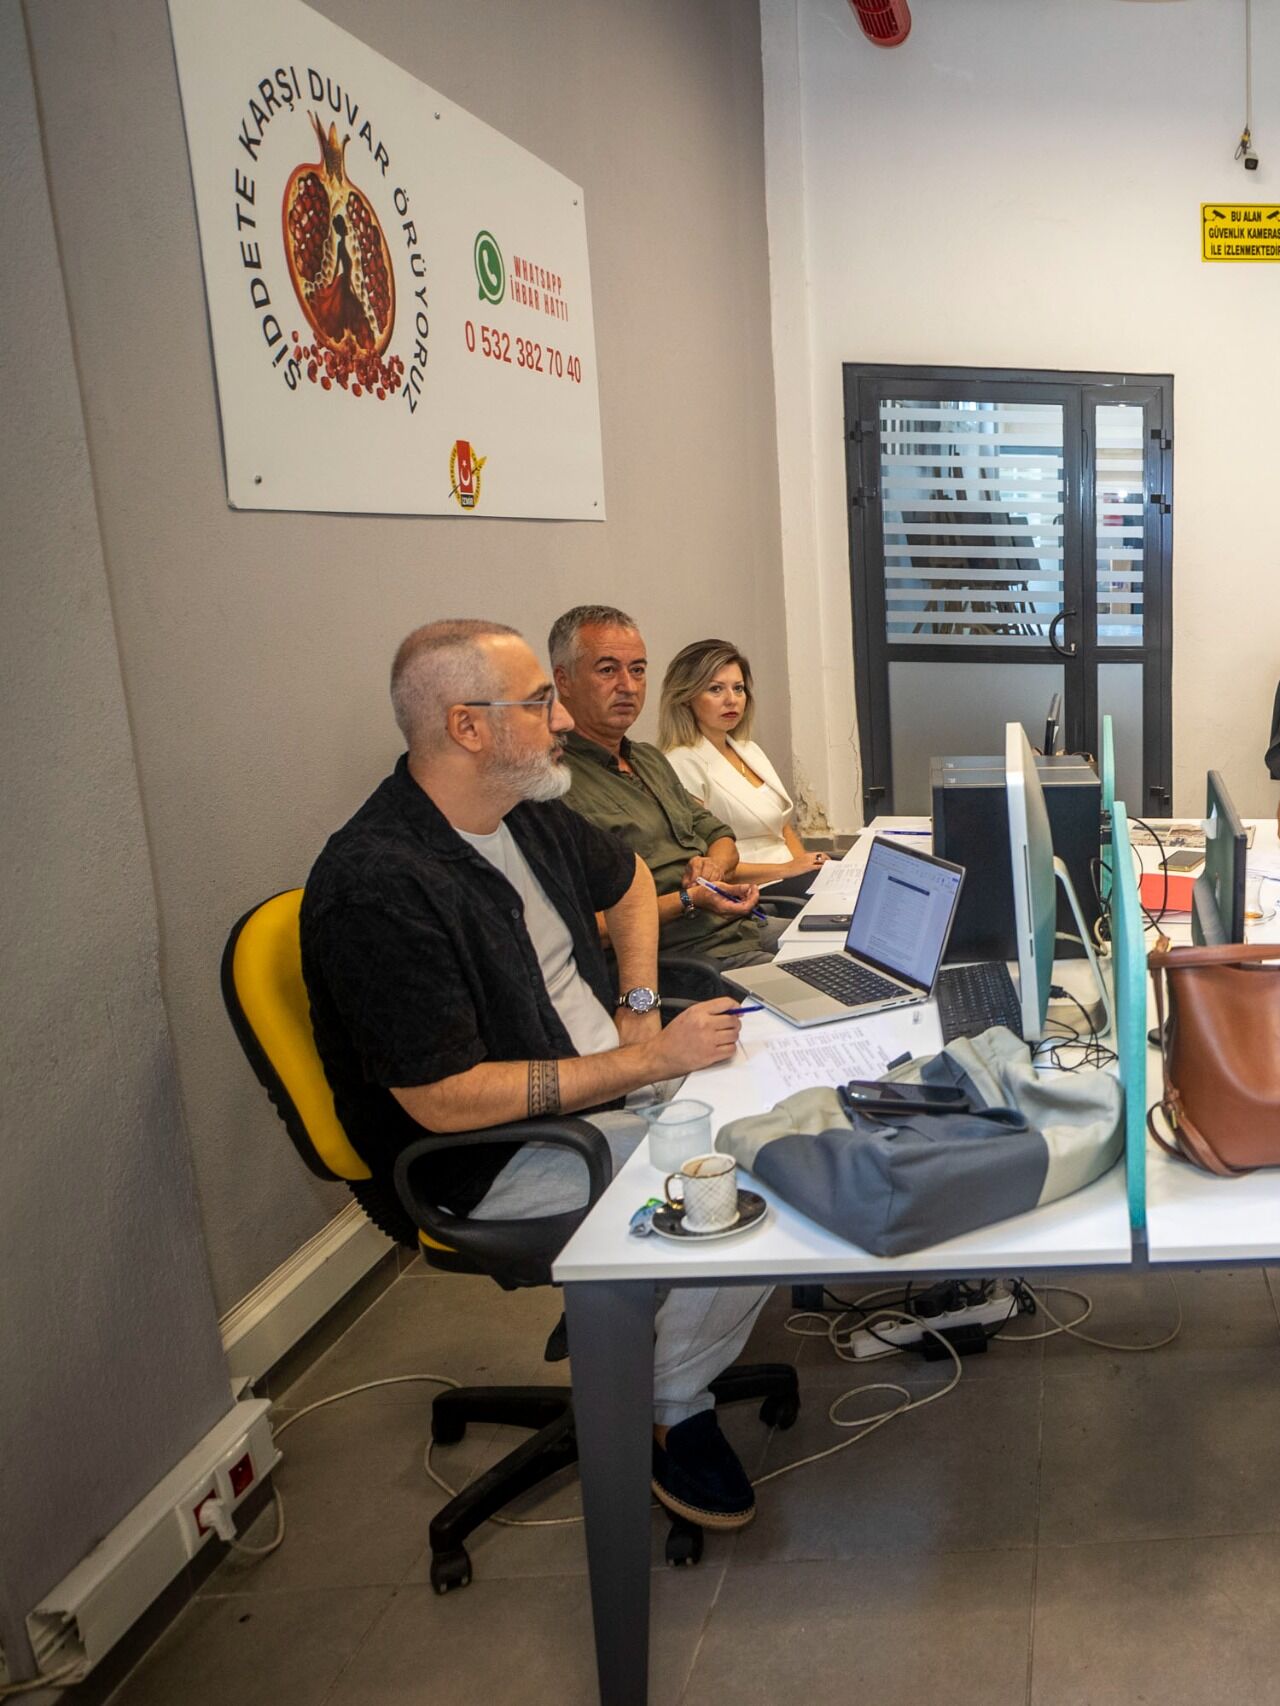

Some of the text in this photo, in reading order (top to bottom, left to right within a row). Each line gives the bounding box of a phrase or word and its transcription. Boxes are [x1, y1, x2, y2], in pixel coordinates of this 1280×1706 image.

[1208, 225, 1245, 239] GÜVENLİK
[1231, 210, 1262, 222] BU ALAN
[235, 66, 429, 415] ŞİDDETE KARŞI DUVAR ÖRÜYORUZ
[1210, 242, 1222, 256] İLE
[513, 255, 562, 296] WHATSAPP
[510, 274, 569, 322] İHBAR HATTI
[465, 320, 582, 384] 0 532 382 70 40
